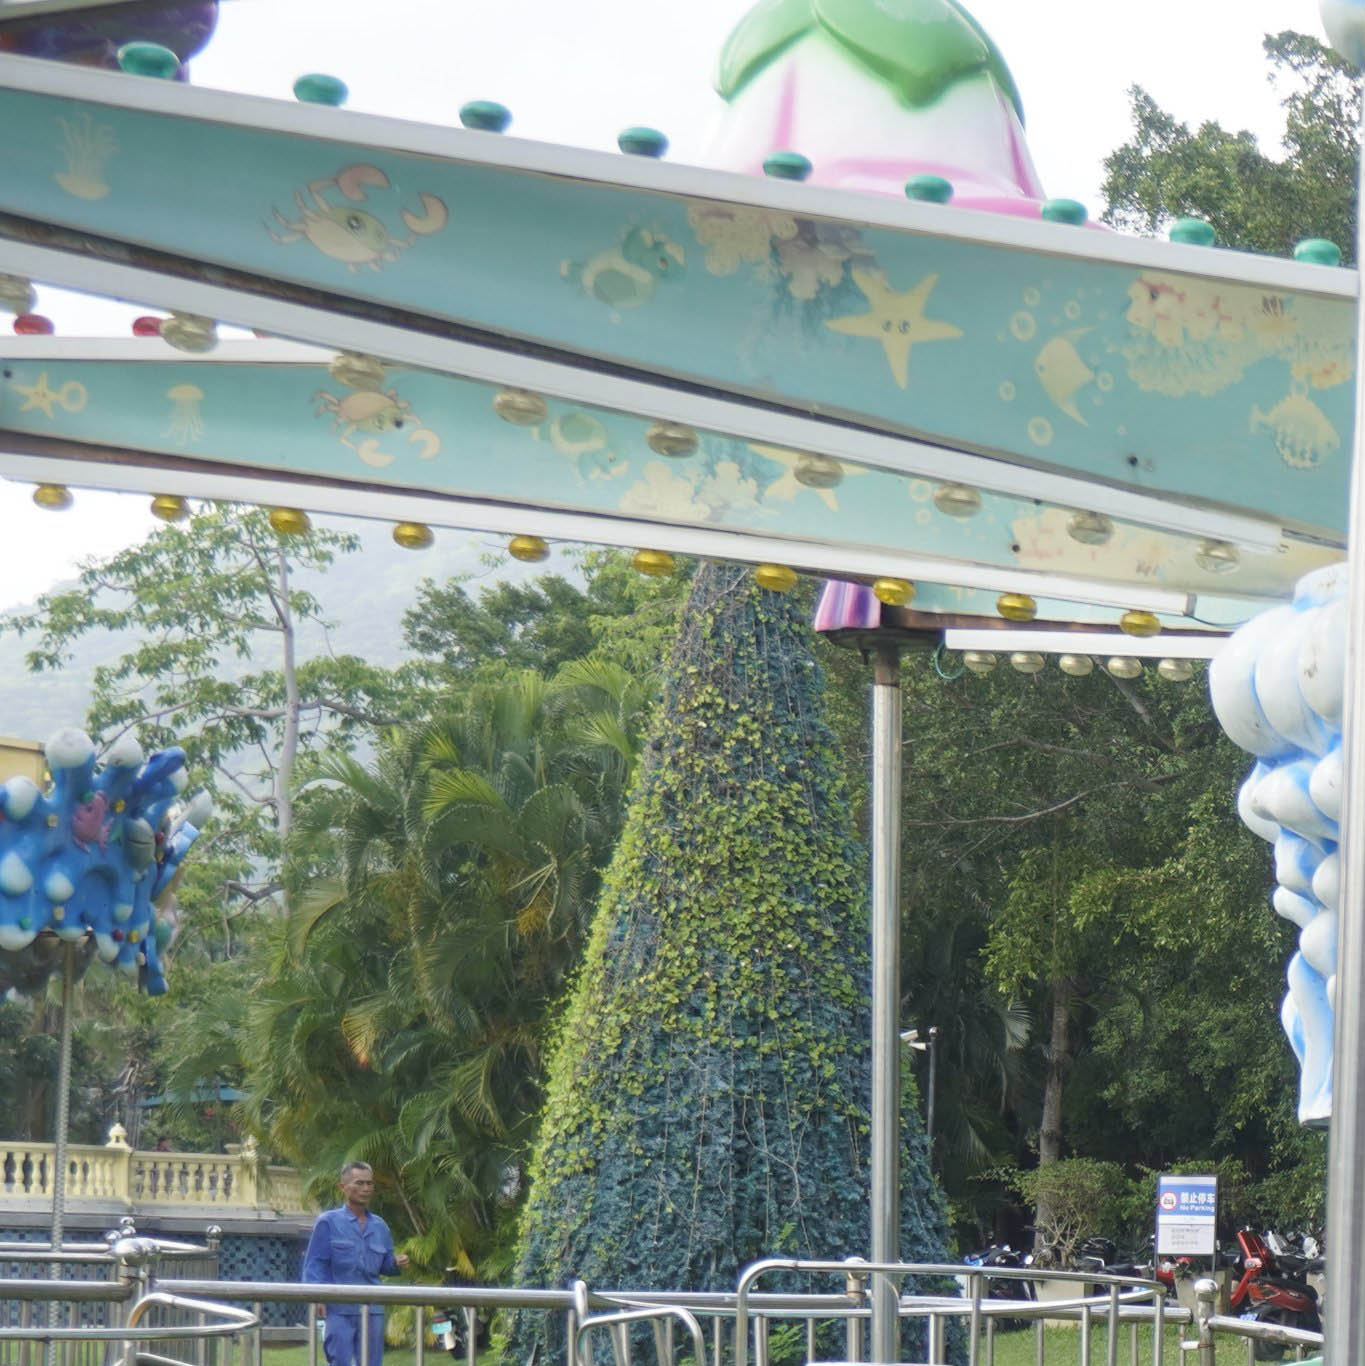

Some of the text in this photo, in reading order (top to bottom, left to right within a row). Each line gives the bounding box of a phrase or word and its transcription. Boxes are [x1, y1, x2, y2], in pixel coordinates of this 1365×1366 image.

[1181, 1192, 1215, 1204] 禁止停车
[1191, 1204, 1215, 1213] Parking
